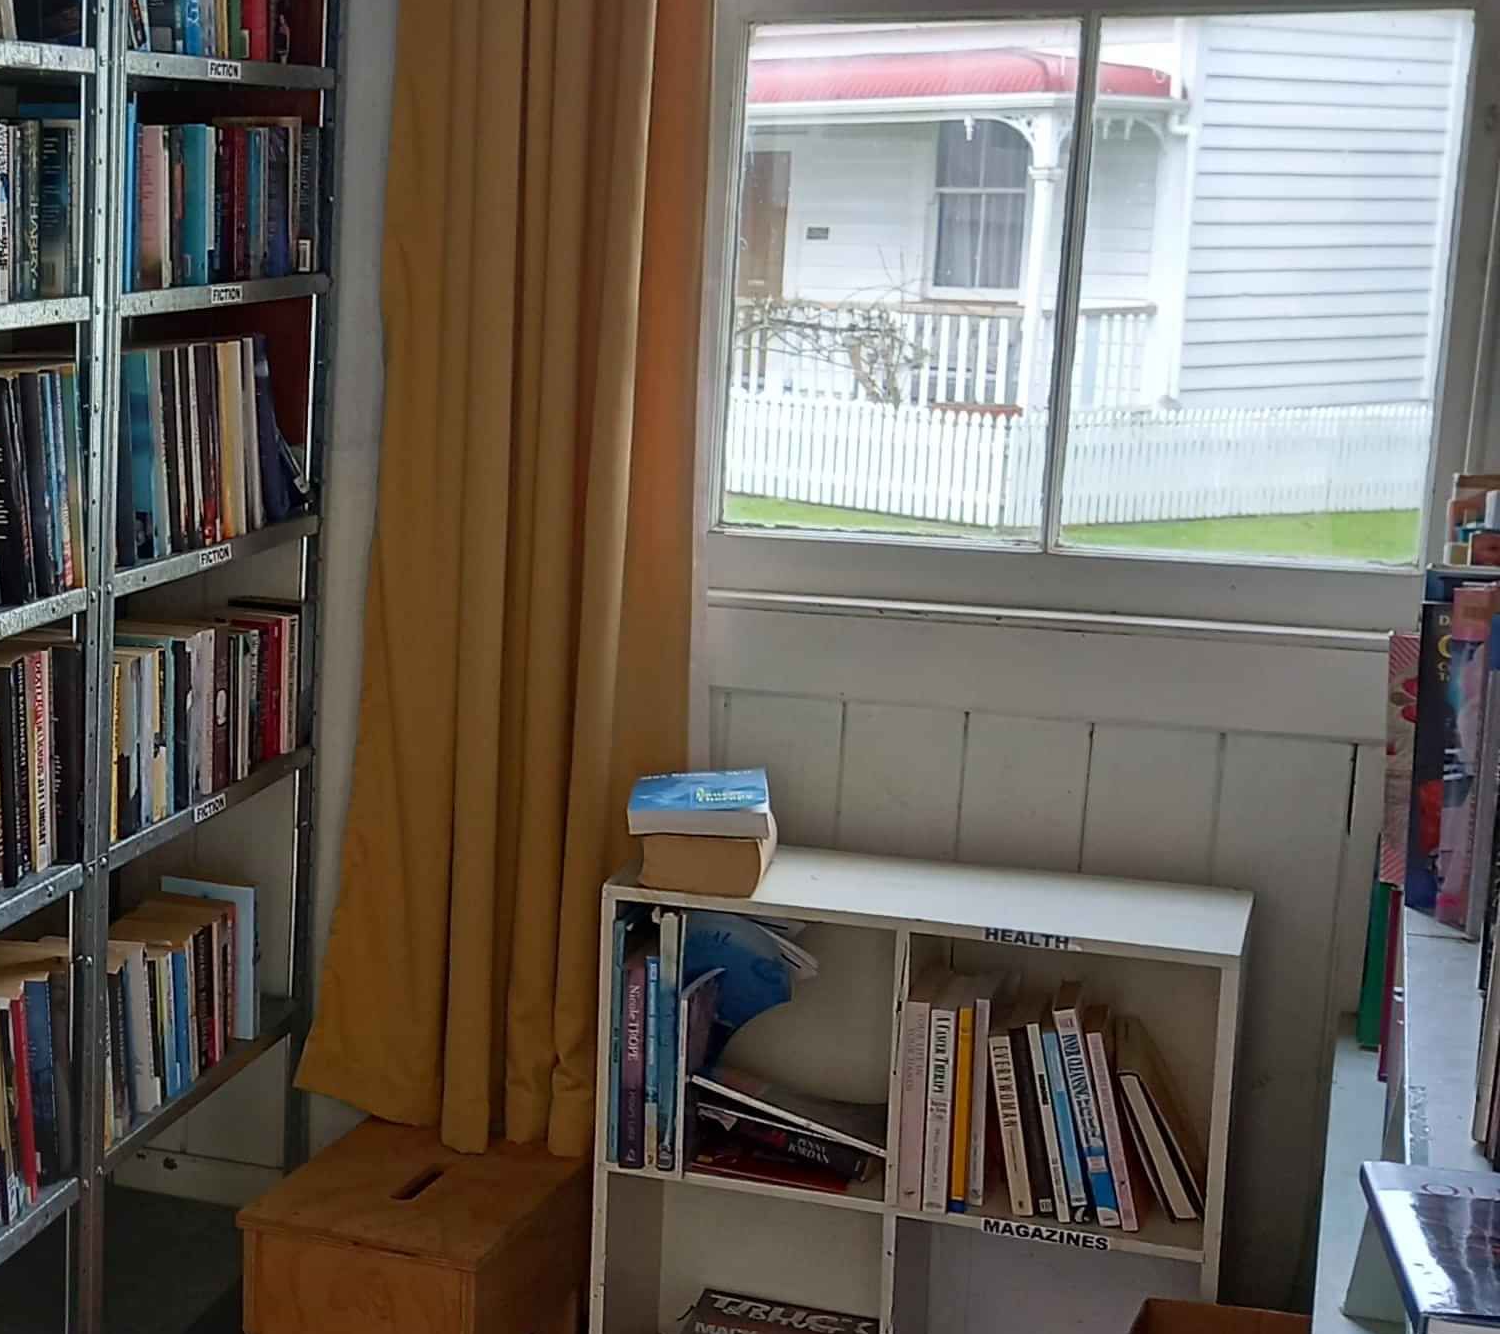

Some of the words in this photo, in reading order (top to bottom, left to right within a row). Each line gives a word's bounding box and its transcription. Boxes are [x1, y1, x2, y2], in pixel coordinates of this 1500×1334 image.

[985, 927, 1069, 949] HEALTH
[627, 1022, 639, 1062] TROPE
[993, 1045, 1017, 1128] EVERYWOMAN
[983, 1218, 1109, 1251] MAGAZINES
